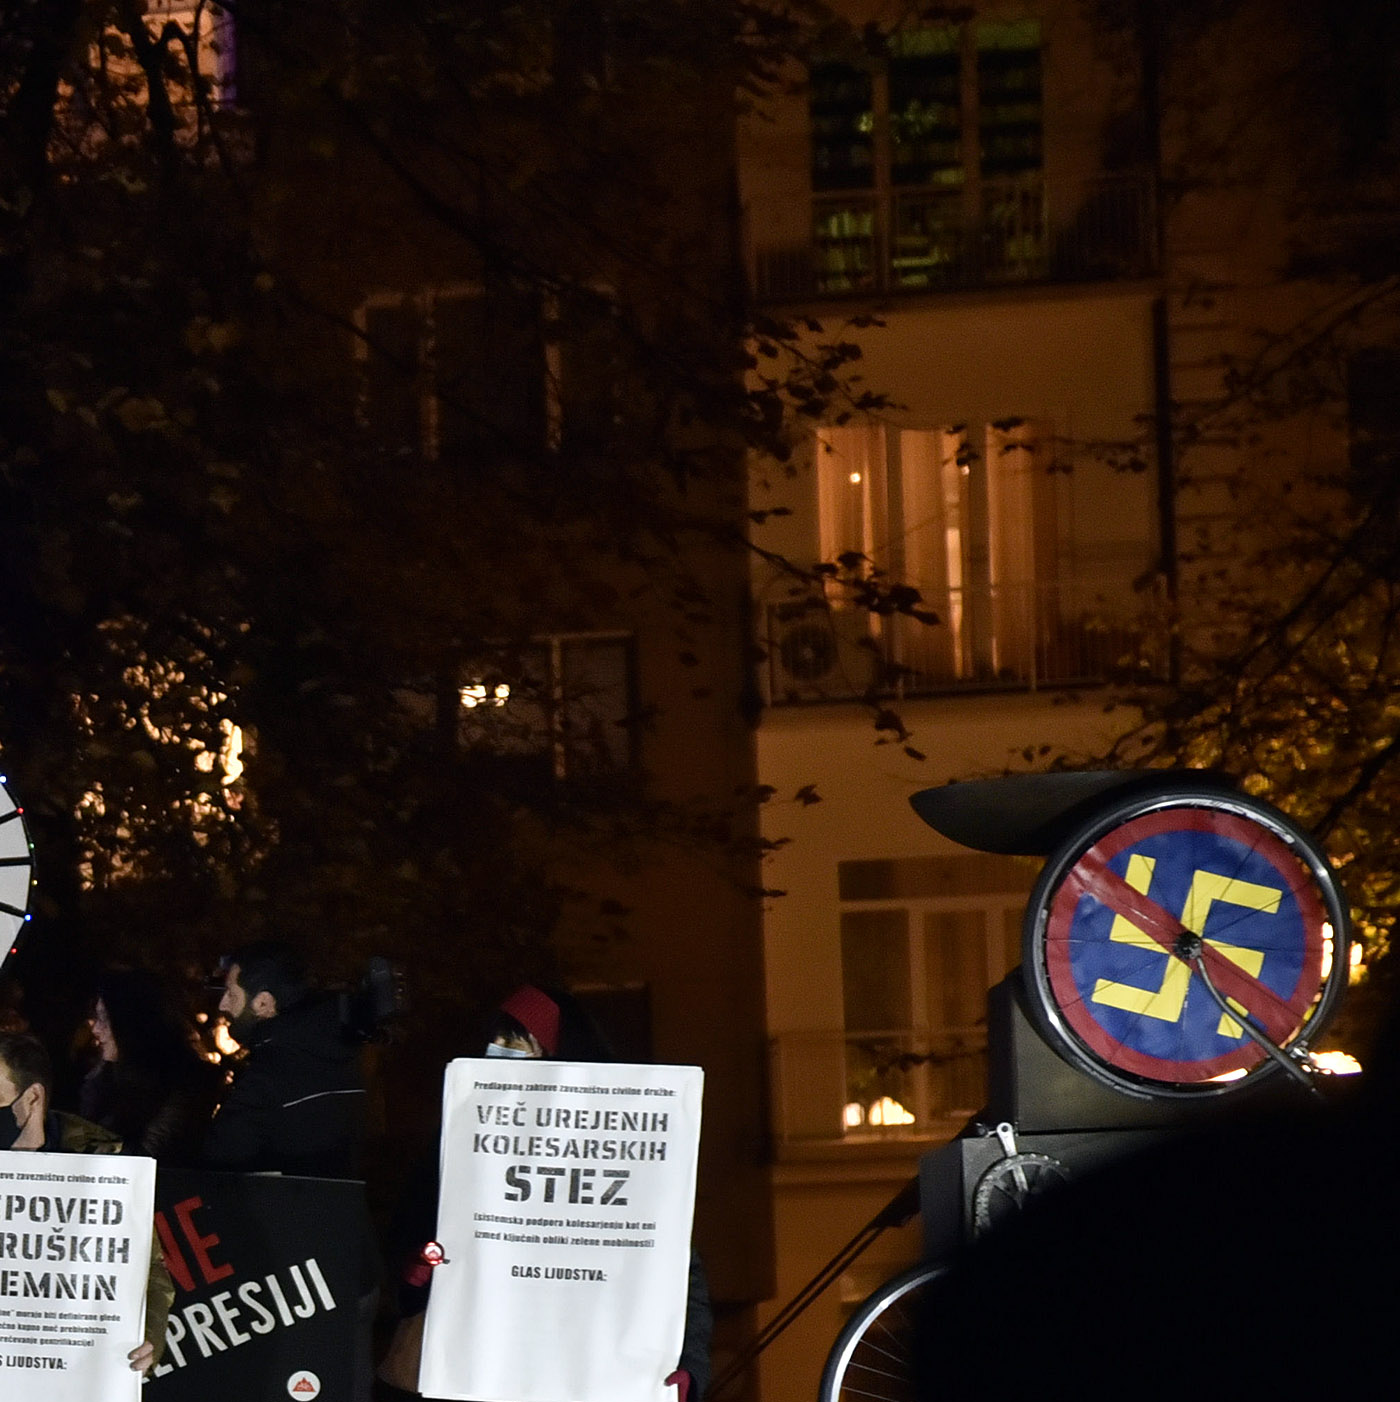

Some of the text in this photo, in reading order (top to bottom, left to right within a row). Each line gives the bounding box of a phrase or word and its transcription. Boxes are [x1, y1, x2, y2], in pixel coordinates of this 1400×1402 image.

[476, 1102, 669, 1132] VEČ UREJENIH
[473, 1134, 667, 1160] KOLESARSKIH
[504, 1165, 630, 1206] STEZ
[511, 1265, 607, 1281] GLAS LJUDSTVA:
[5, 1355, 67, 1370] LJUDSTVA:
